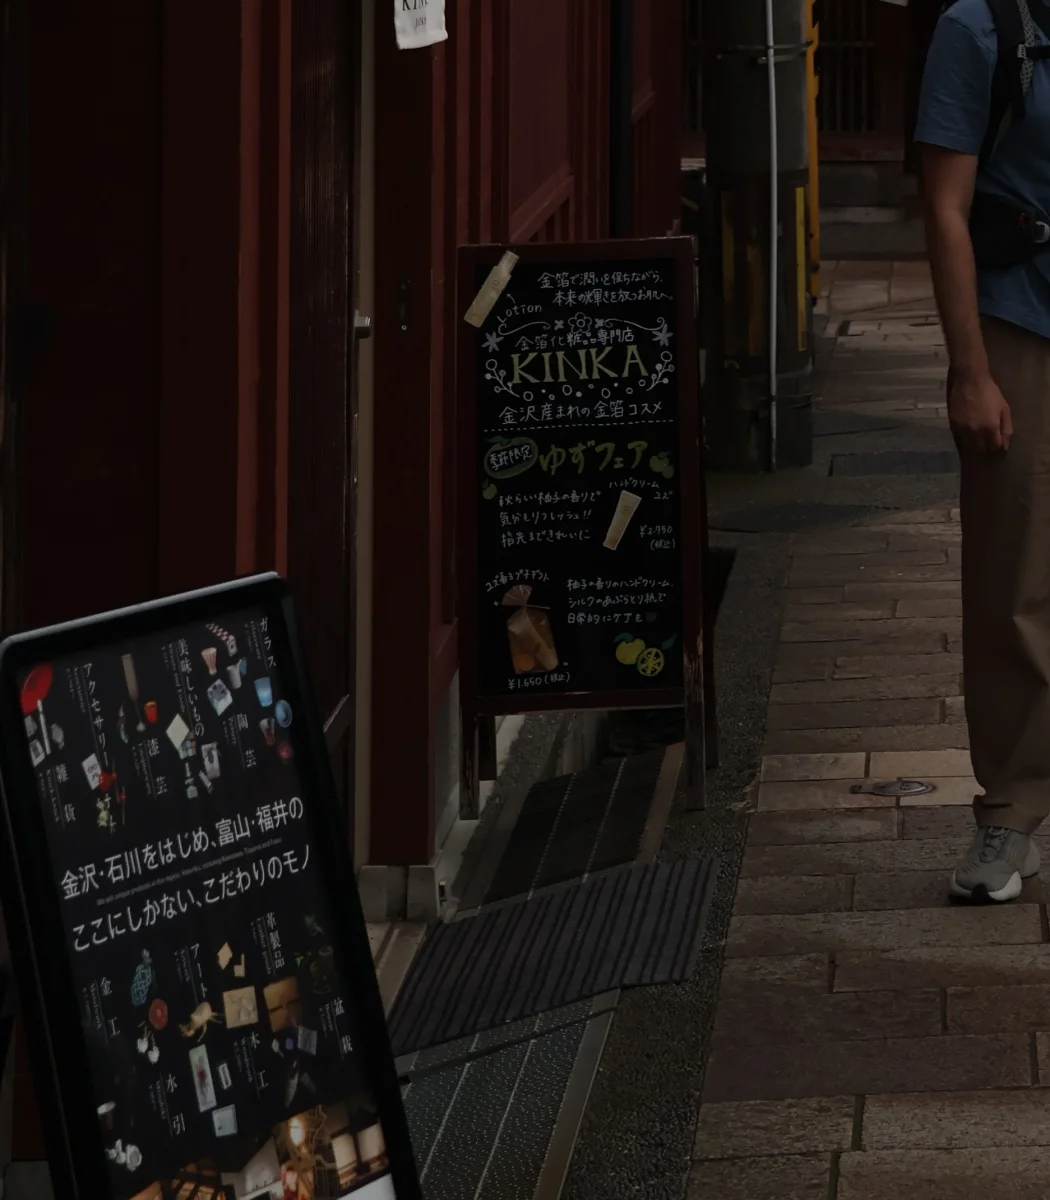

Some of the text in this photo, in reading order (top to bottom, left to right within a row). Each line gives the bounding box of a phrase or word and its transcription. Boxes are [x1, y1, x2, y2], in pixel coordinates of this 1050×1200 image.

[515, 327, 635, 351] 金箔化粧品専門店
[510, 344, 649, 384] KINKA
[538, 440, 649, 476] ゆずフェア
[259, 616, 277, 668] ガラス
[73, 844, 310, 952] ここにしかない、こだわりのモノ
